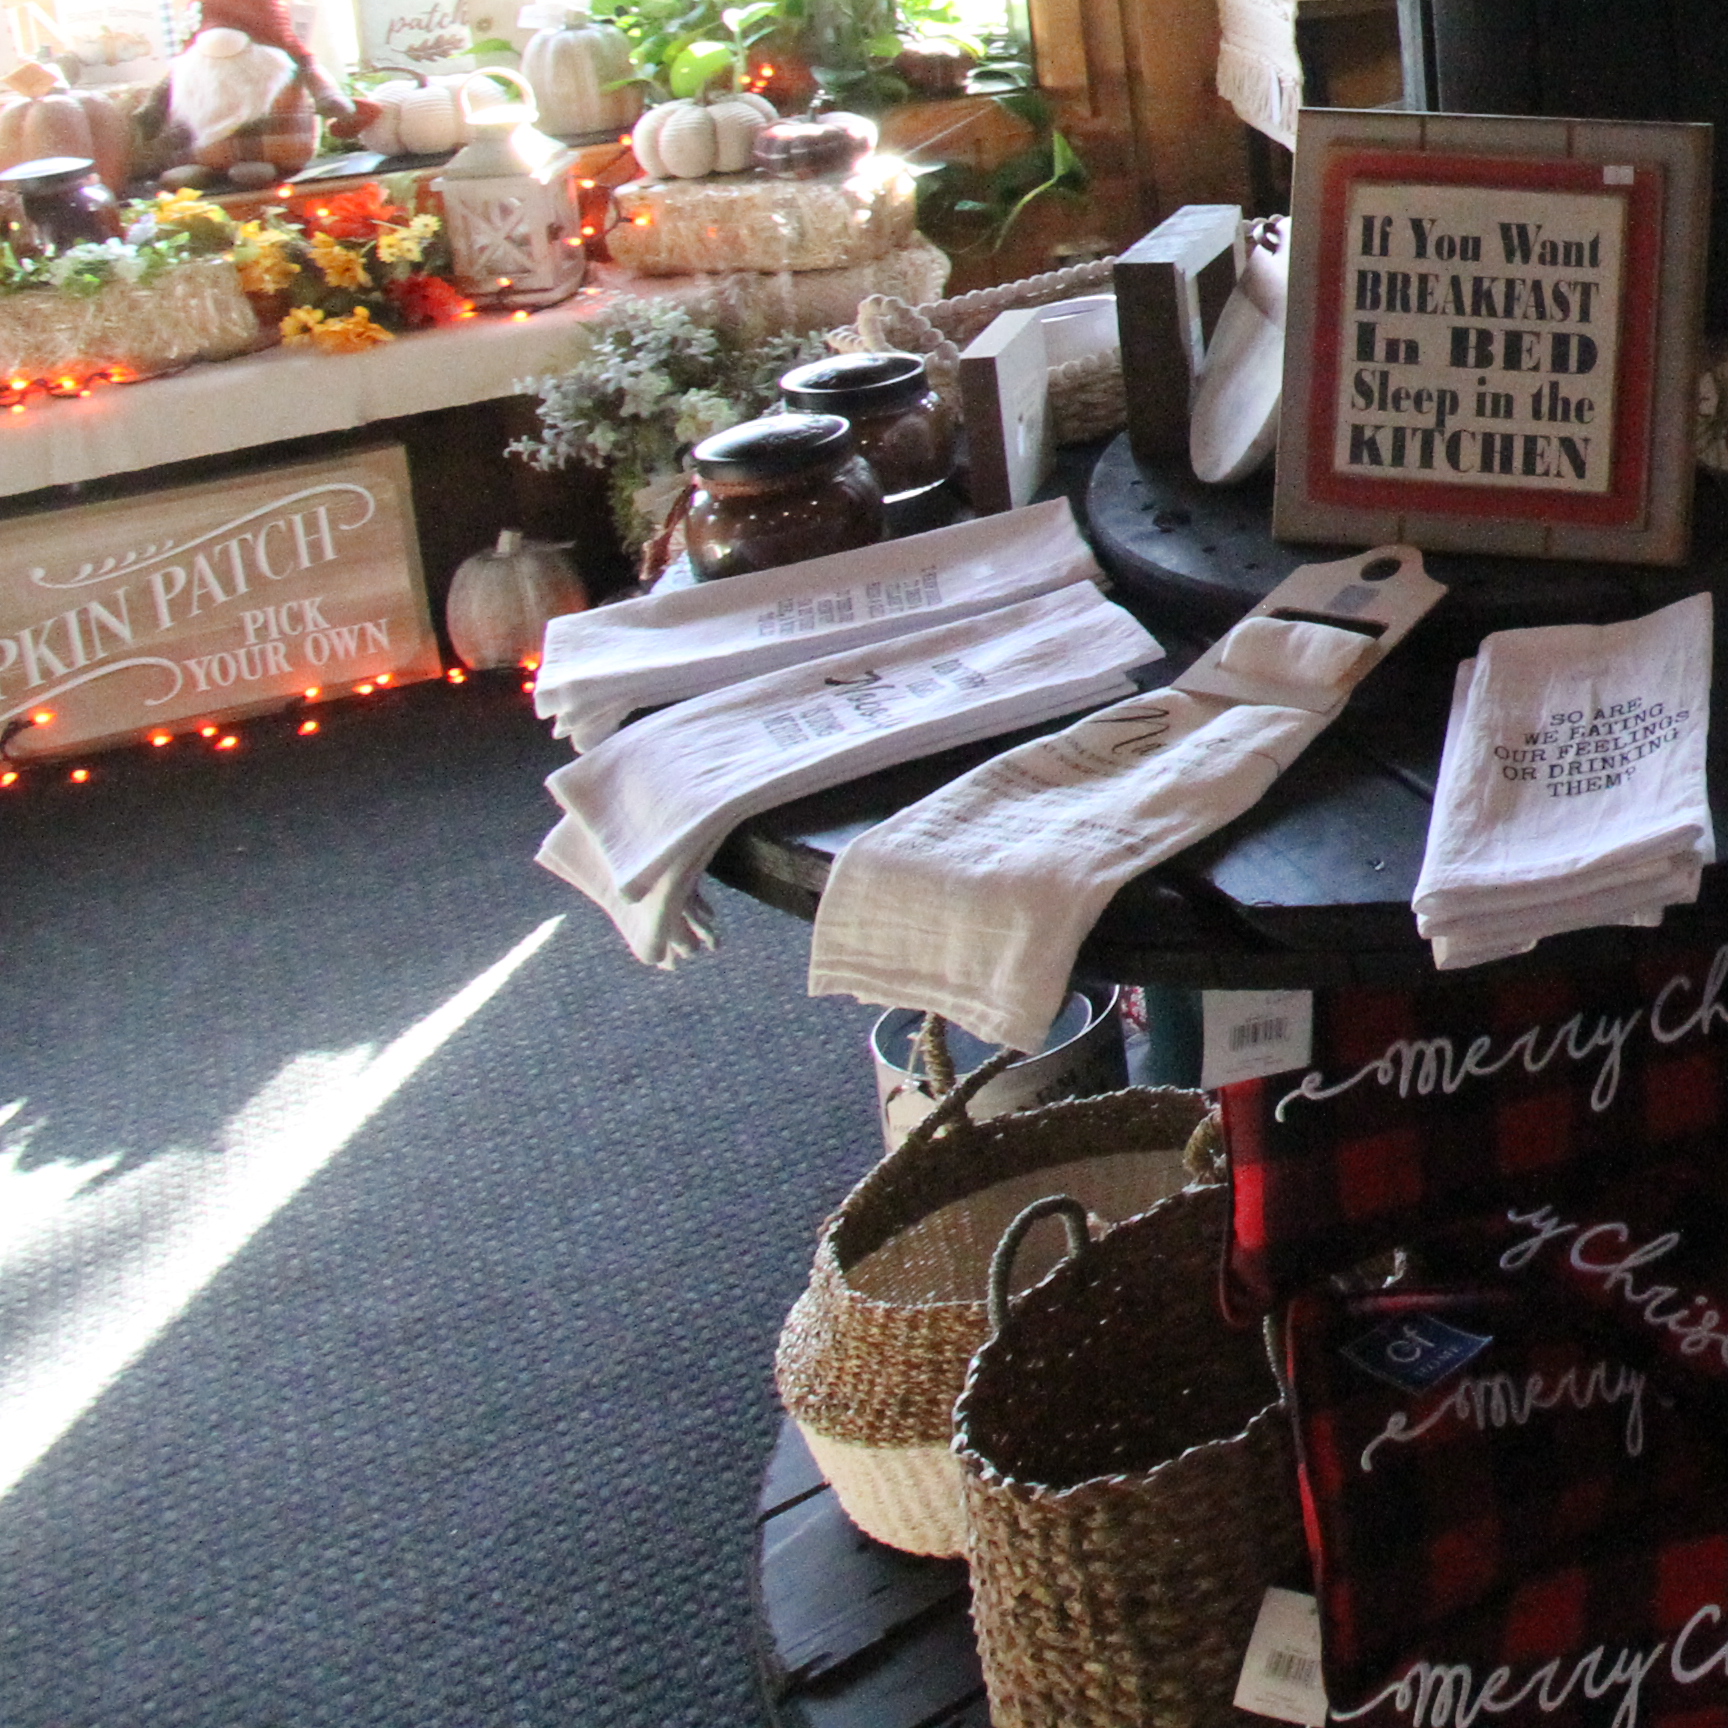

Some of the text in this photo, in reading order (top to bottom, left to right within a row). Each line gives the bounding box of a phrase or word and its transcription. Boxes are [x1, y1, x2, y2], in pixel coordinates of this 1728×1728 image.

[1360, 214, 1601, 269] If You Want
[1355, 269, 1600, 324] BREAKFAST
[1352, 321, 1598, 375] In BED
[1351, 368, 1596, 429] Sleep in the
[1349, 423, 1591, 480] KITCHEN
[146, 505, 338, 631] PATCH
[239, 596, 331, 646] PICK
[180, 618, 390, 691] YOUR OWN
[1494, 710, 1691, 763] OUR FEELINGS
[1524, 703, 1665, 746] WE EATING
[1550, 697, 1643, 726] SO ARE
[1502, 728, 1680, 781] OR DRINKING
[1546, 766, 1636, 797] THEM?
[1274, 1007, 1650, 1122] merry
[1360, 1362, 1649, 1472] merry
[1330, 1638, 1665, 1728] merry
